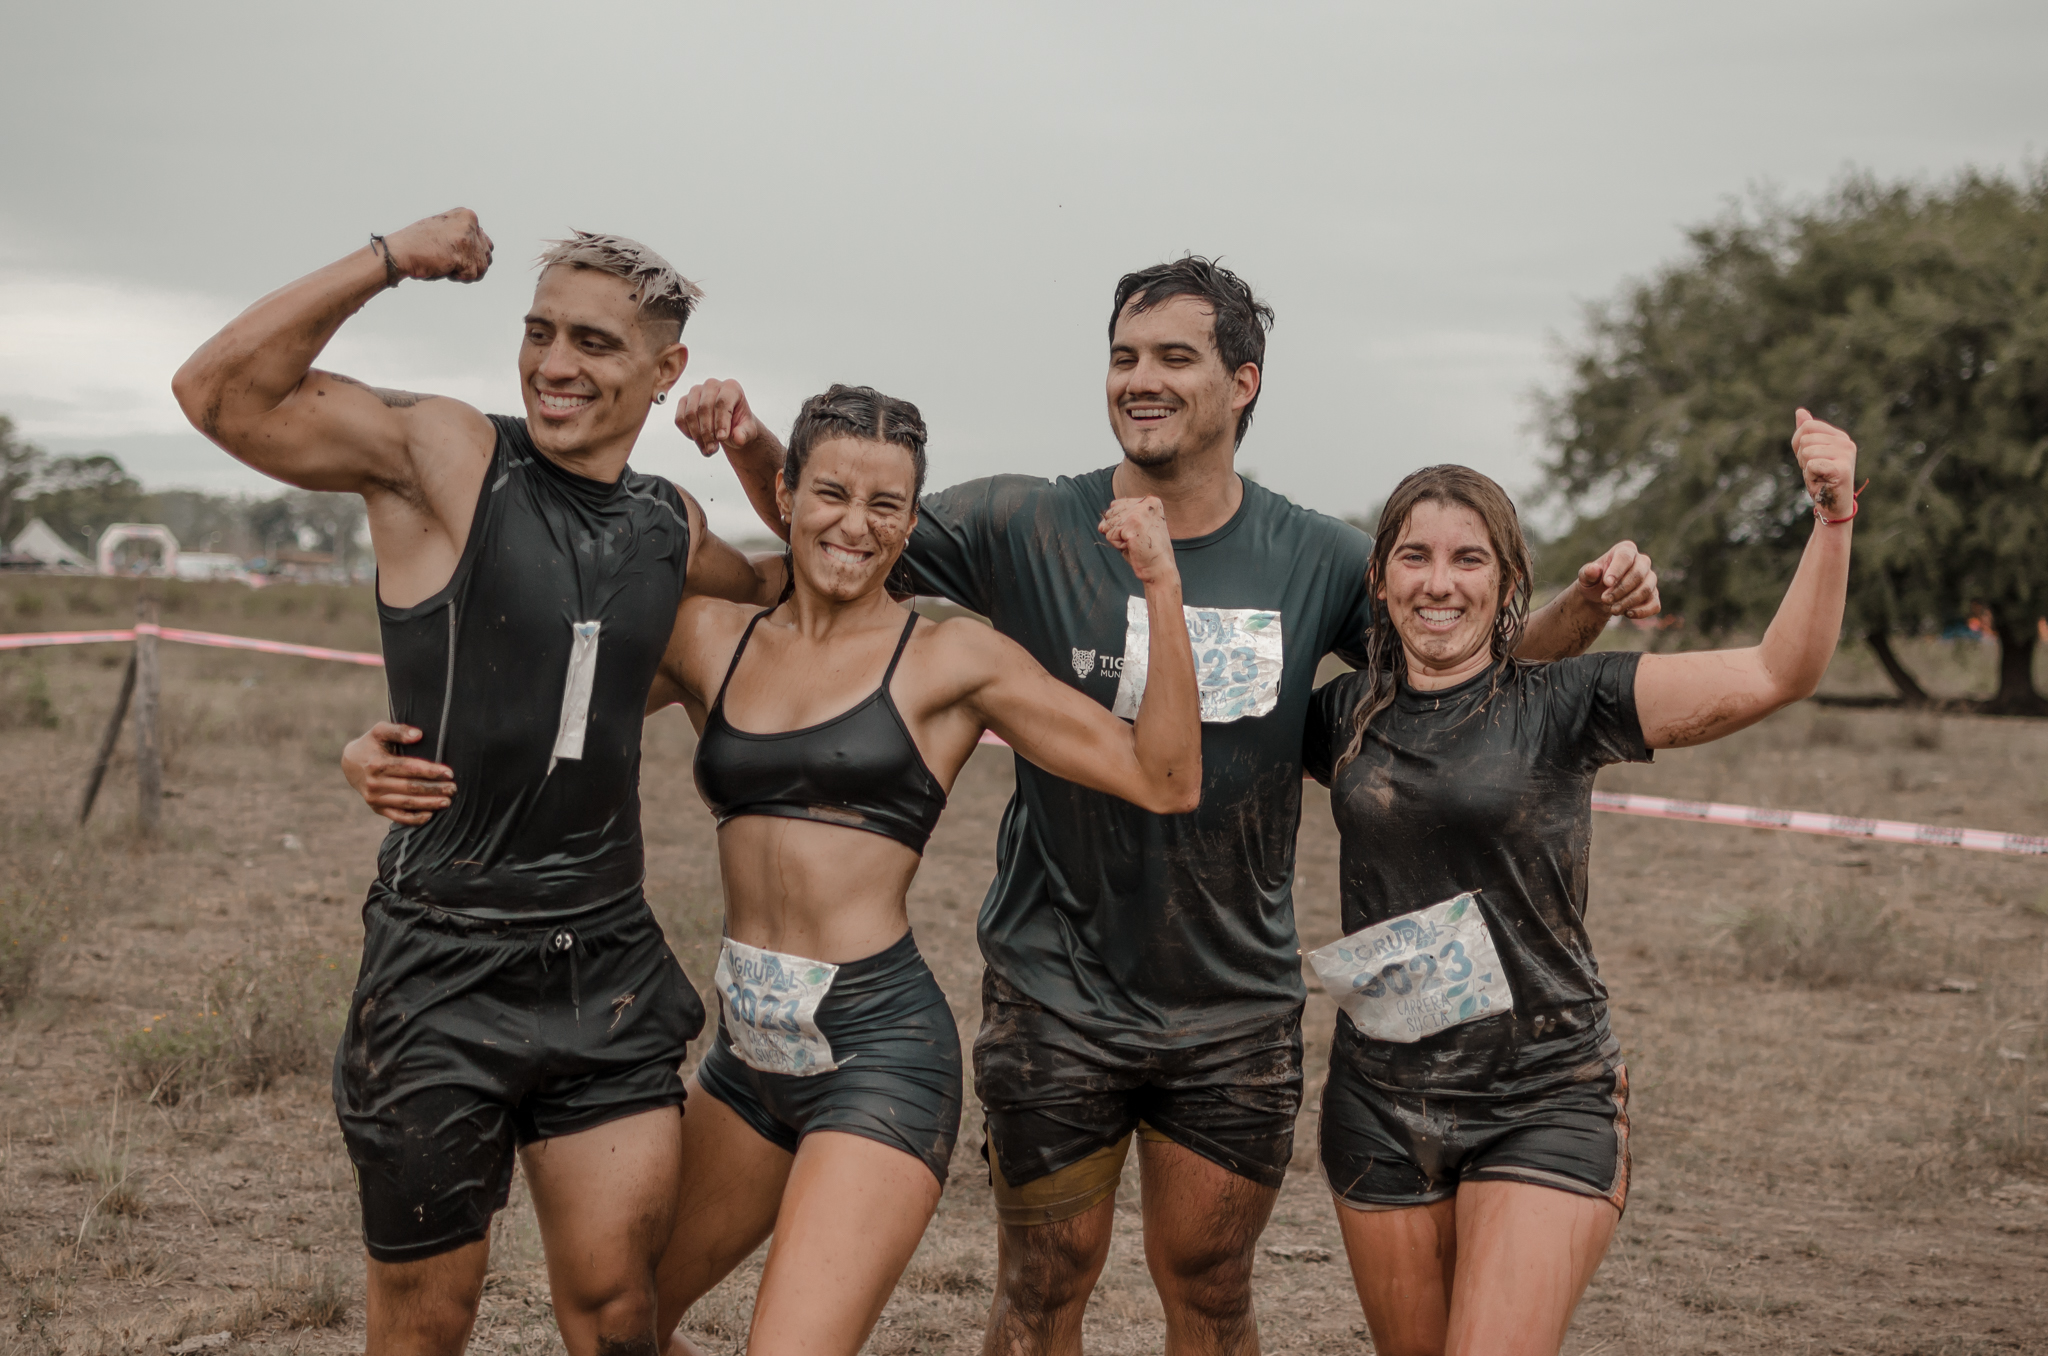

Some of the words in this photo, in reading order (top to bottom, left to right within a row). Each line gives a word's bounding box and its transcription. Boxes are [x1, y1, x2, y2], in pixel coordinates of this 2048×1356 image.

[1186, 619, 1239, 639] RUPAL
[1099, 655, 1124, 671] TIG
[1100, 669, 1121, 679] MUN
[1192, 647, 1259, 687] 23
[1354, 920, 1444, 961] GRUPAL
[734, 956, 798, 989] GRUPAL
[1352, 940, 1473, 999] 3023
[1396, 992, 1452, 1016] CARRERA
[1406, 1012, 1451, 1033] SUCIA
[755, 1047, 789, 1067] SUCIA
